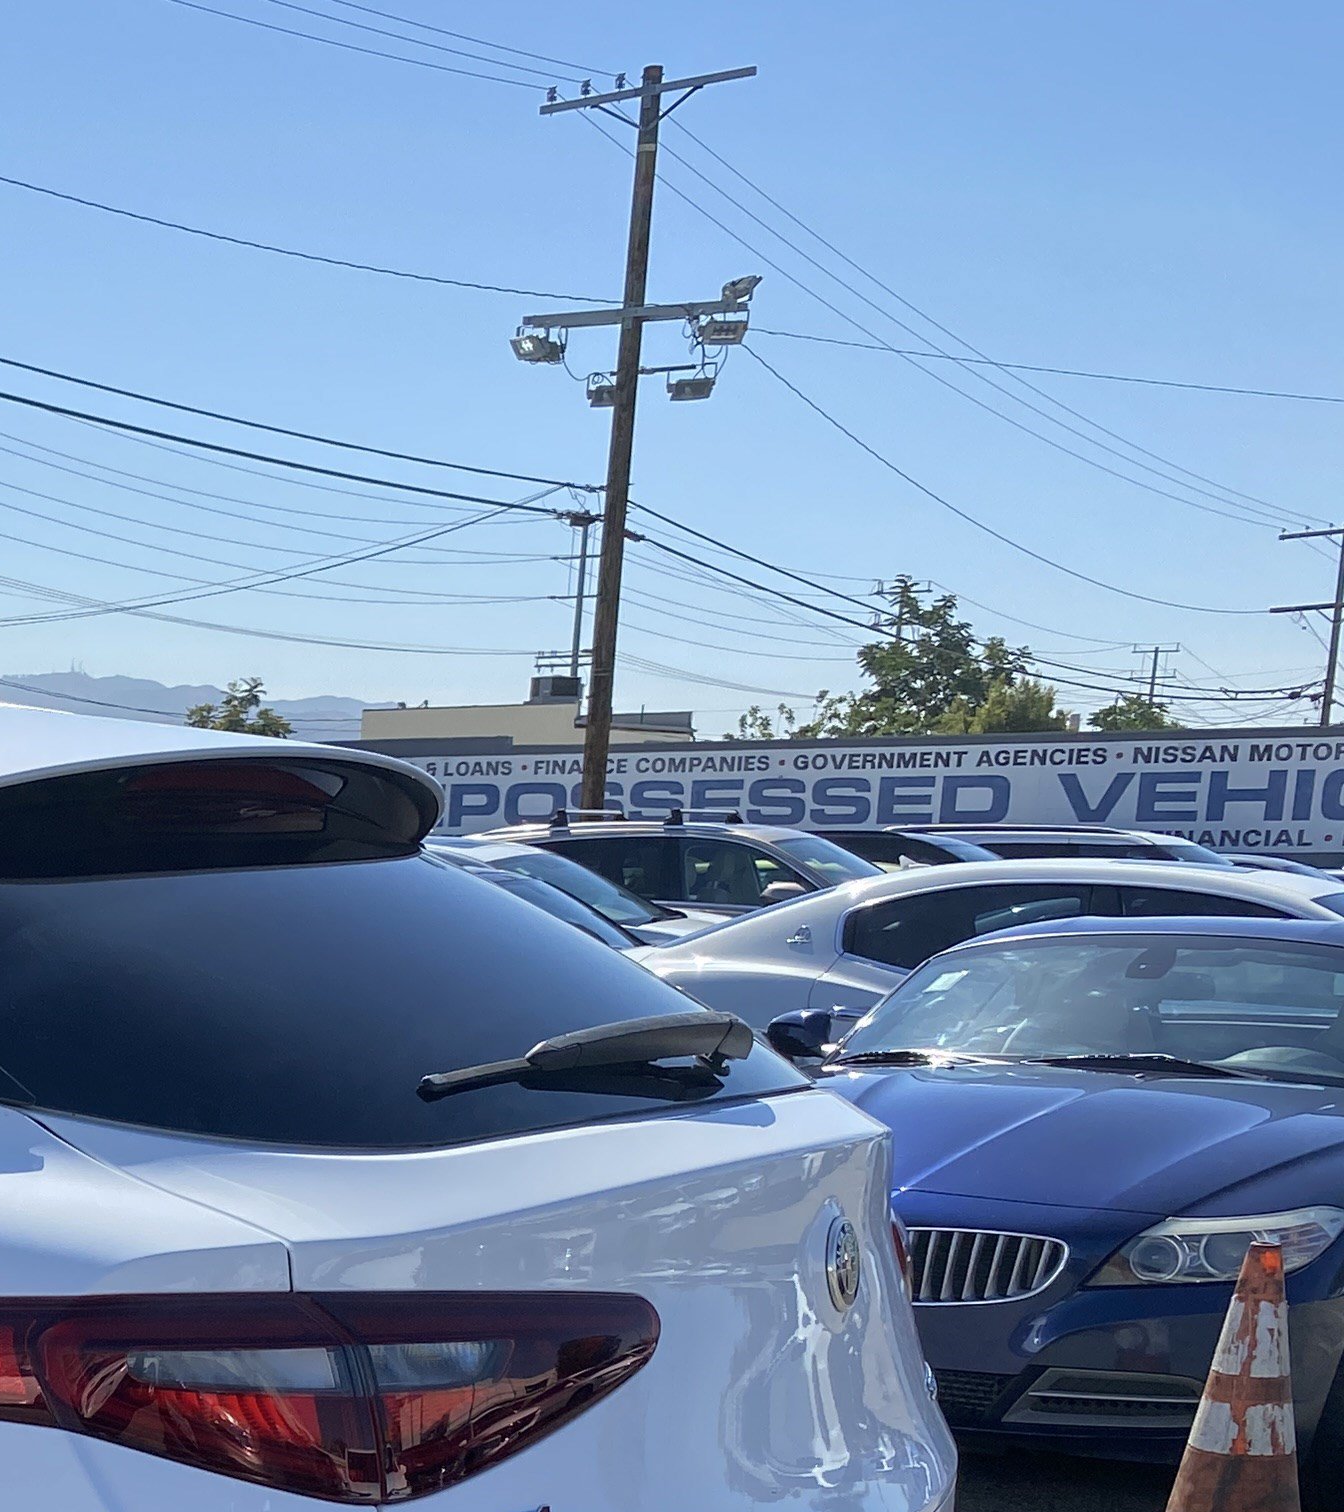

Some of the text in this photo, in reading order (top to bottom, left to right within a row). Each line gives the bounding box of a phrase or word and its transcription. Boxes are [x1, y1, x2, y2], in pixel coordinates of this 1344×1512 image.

[444, 760, 513, 777] LOANS
[533, 758, 629, 776] FINACE
[635, 755, 770, 774] COMPANIES
[793, 750, 968, 771] GOVERNMENT
[976, 747, 1108, 767] AGENCIES
[1132, 744, 1239, 765] NISSAN
[440, 775, 1011, 827] POSSESSED
